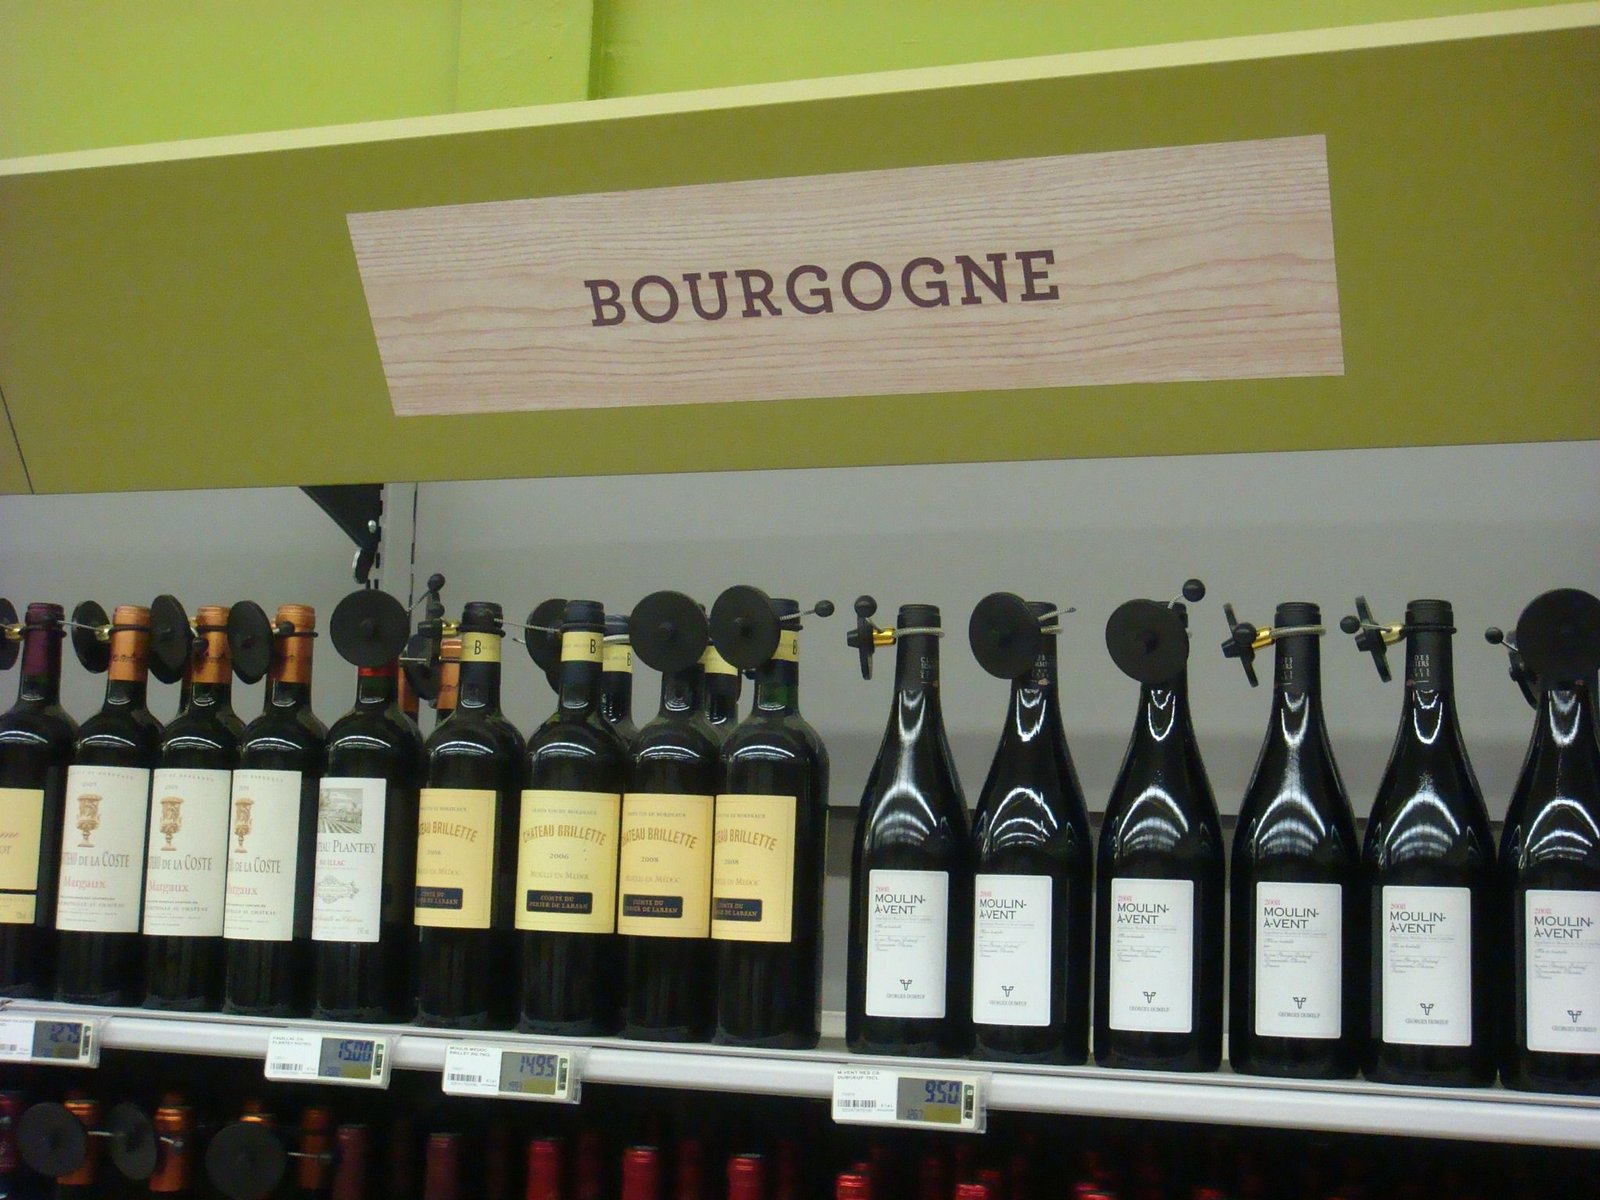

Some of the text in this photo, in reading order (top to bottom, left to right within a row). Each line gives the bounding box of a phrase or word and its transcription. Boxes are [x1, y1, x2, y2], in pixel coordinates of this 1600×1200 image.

[584, 249, 1060, 327] BOURGOGNE
[474, 641, 481, 655] B
[590, 639, 597, 654] B
[432, 821, 479, 844] BRILLETTE
[557, 824, 607, 846] BRILLETTE
[647, 827, 698, 850] BRILLETTE
[729, 828, 779, 852] BRILLETTE
[333, 839, 376, 854] PLANTEY
[79, 856, 88, 867] DE
[90, 856, 100, 867] LA
[102, 851, 130, 868] COSTE
[173, 859, 183, 870] LA
[184, 854, 213, 872] COSTE
[254, 856, 281, 874] COSTE
[64, 876, 106, 890] Margaux
[875, 893, 926, 904] MOULIN-
[979, 898, 1027, 909] MOULIN-
[1117, 903, 1170, 914] MOULIN-
[1263, 907, 1320, 918] MOULIN-
[1389, 911, 1447, 922] MOULIN-
[1534, 916, 1594, 927] MOULIN-
